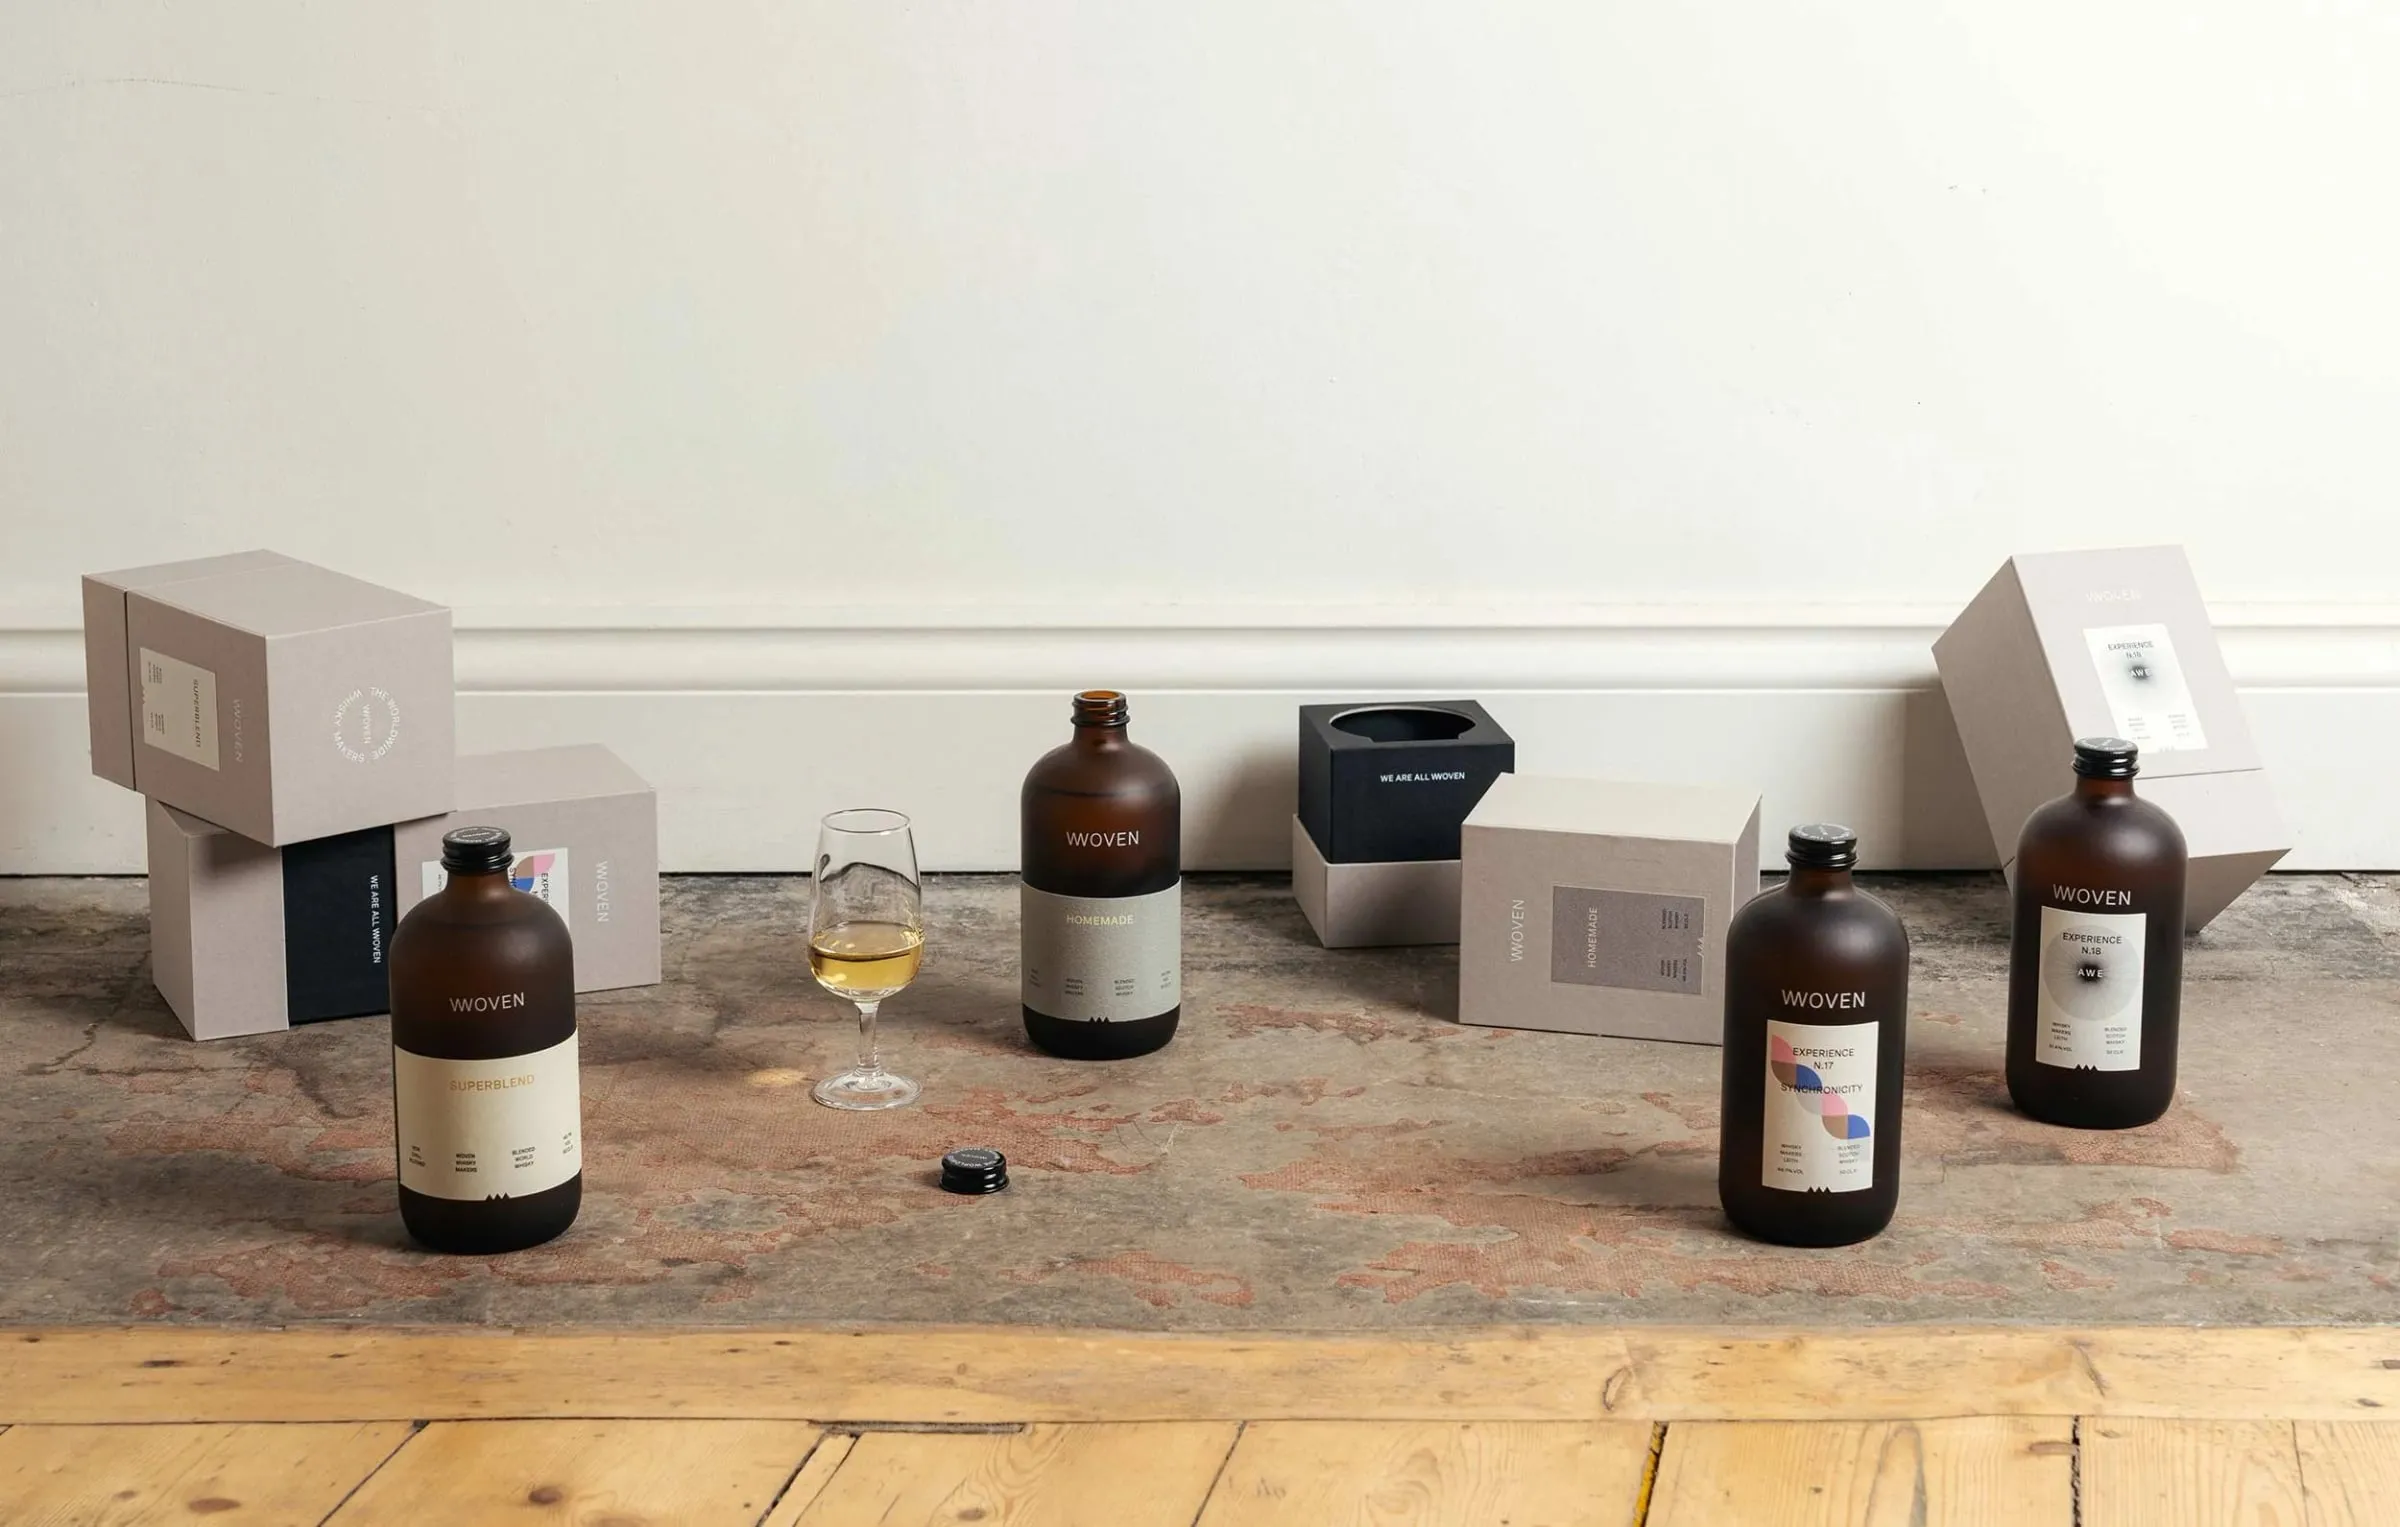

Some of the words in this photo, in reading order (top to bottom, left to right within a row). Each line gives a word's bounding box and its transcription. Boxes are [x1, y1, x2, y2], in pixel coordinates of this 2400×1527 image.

[2108, 641, 2153, 651] EXPERIENCE
[2131, 668, 2151, 677] AWE
[369, 686, 389, 701] THE
[193, 679, 201, 748] SUPERBLEND
[334, 689, 363, 727] WHISKY
[233, 699, 243, 763] WOVEN
[362, 704, 372, 744] WOVEN
[371, 698, 400, 760] WORLDWIDE
[333, 731, 365, 762] MAKERS
[1414, 773, 1430, 781] ALL
[1430, 772, 1465, 781] WOVEN
[1066, 831, 1140, 848] WOVEN
[370, 874, 379, 889] WE
[596, 860, 609, 922] WOVEN
[2053, 884, 2131, 906] WOVEN
[371, 891, 380, 909] ARE
[372, 910, 380, 927] ALL
[1067, 915, 1134, 925] HOMEMADE
[1511, 899, 1525, 962] WOVEN
[1588, 906, 1598, 968] HOMEMADE
[2062, 932, 2122, 944] EXPERIENCE
[372, 927, 381, 964] WOVEN
[2081, 946, 2102, 955] N.18
[2077, 968, 2104, 978] AWE
[450, 992, 525, 1012] WOVEN
[1781, 989, 1865, 1009] WOVEN
[1792, 1047, 1855, 1057] EXPERIENCE
[1813, 1061, 1834, 1070] N.17
[450, 1074, 535, 1091] SUPERBLEND
[1780, 1083, 1863, 1094] SYNCHRONICITY
